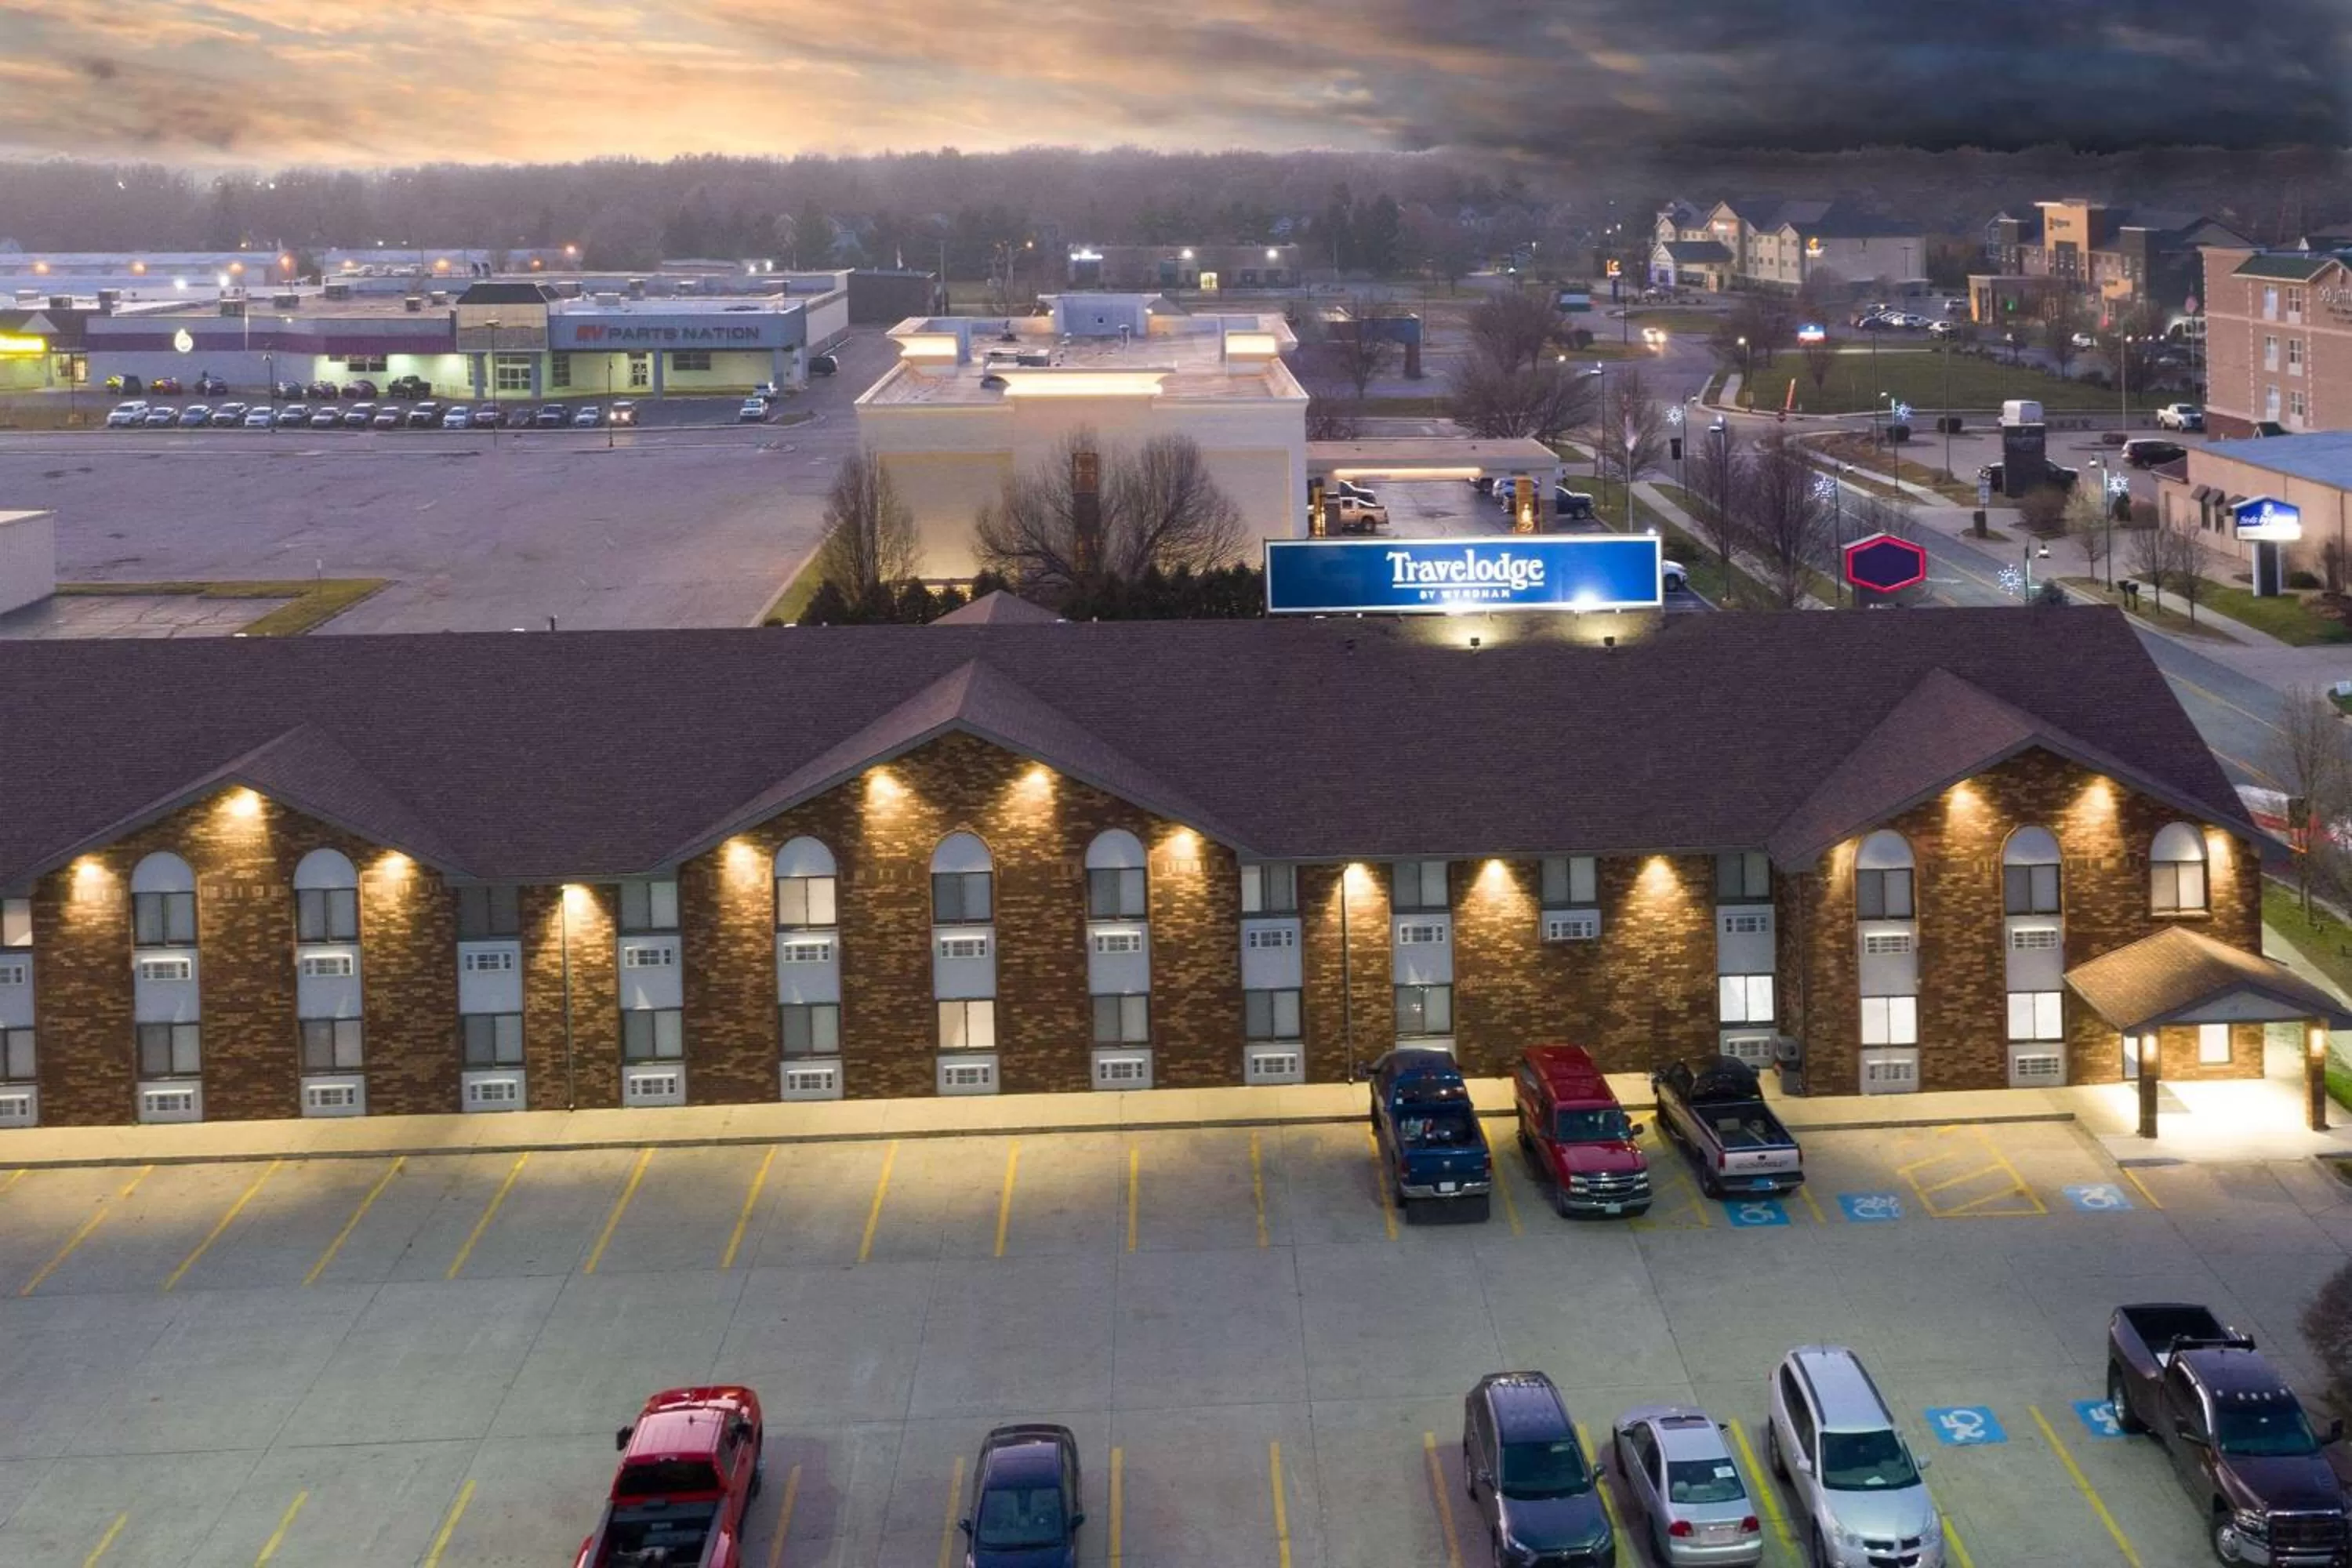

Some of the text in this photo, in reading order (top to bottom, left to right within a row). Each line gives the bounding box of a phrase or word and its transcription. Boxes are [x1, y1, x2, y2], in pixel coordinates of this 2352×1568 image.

[608, 326, 678, 339] PARTS
[681, 326, 759, 339] NATION
[1386, 549, 1544, 590] Travelodge
[1420, 590, 1510, 600] BY WYNDHAM
